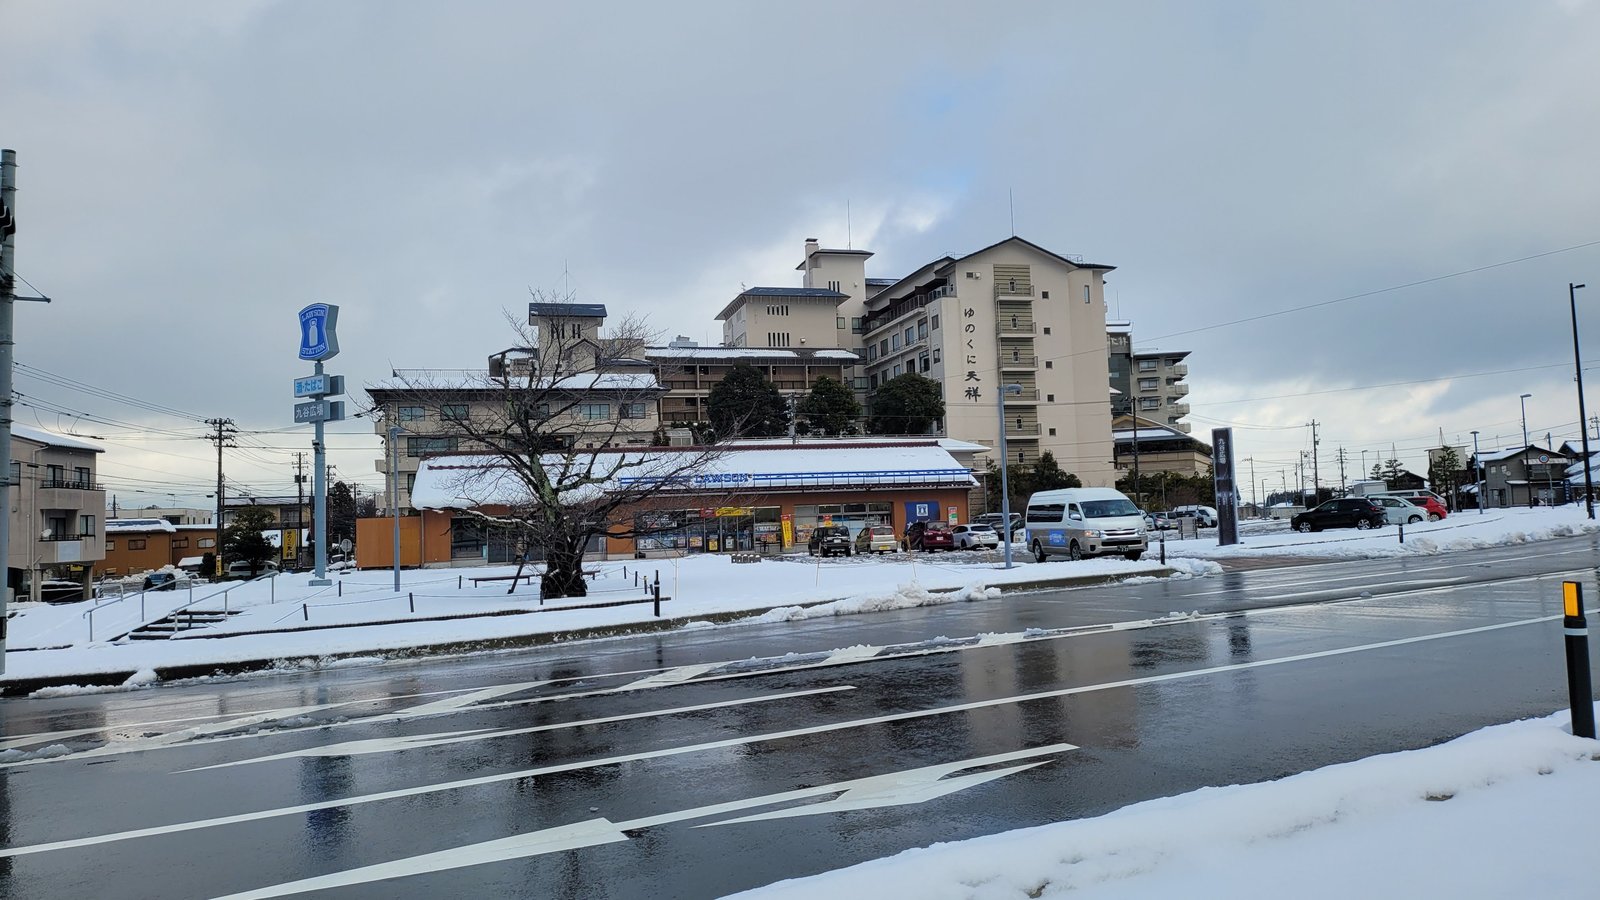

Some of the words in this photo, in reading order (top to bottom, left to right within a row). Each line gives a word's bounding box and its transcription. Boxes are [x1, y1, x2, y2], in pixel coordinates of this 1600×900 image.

[302, 309, 326, 321] LAWSON
[302, 342, 326, 355] STATION
[964, 307, 982, 403] ゆのくに天祥
[296, 403, 323, 418] 九谷広場
[694, 473, 749, 483] LAWSON
